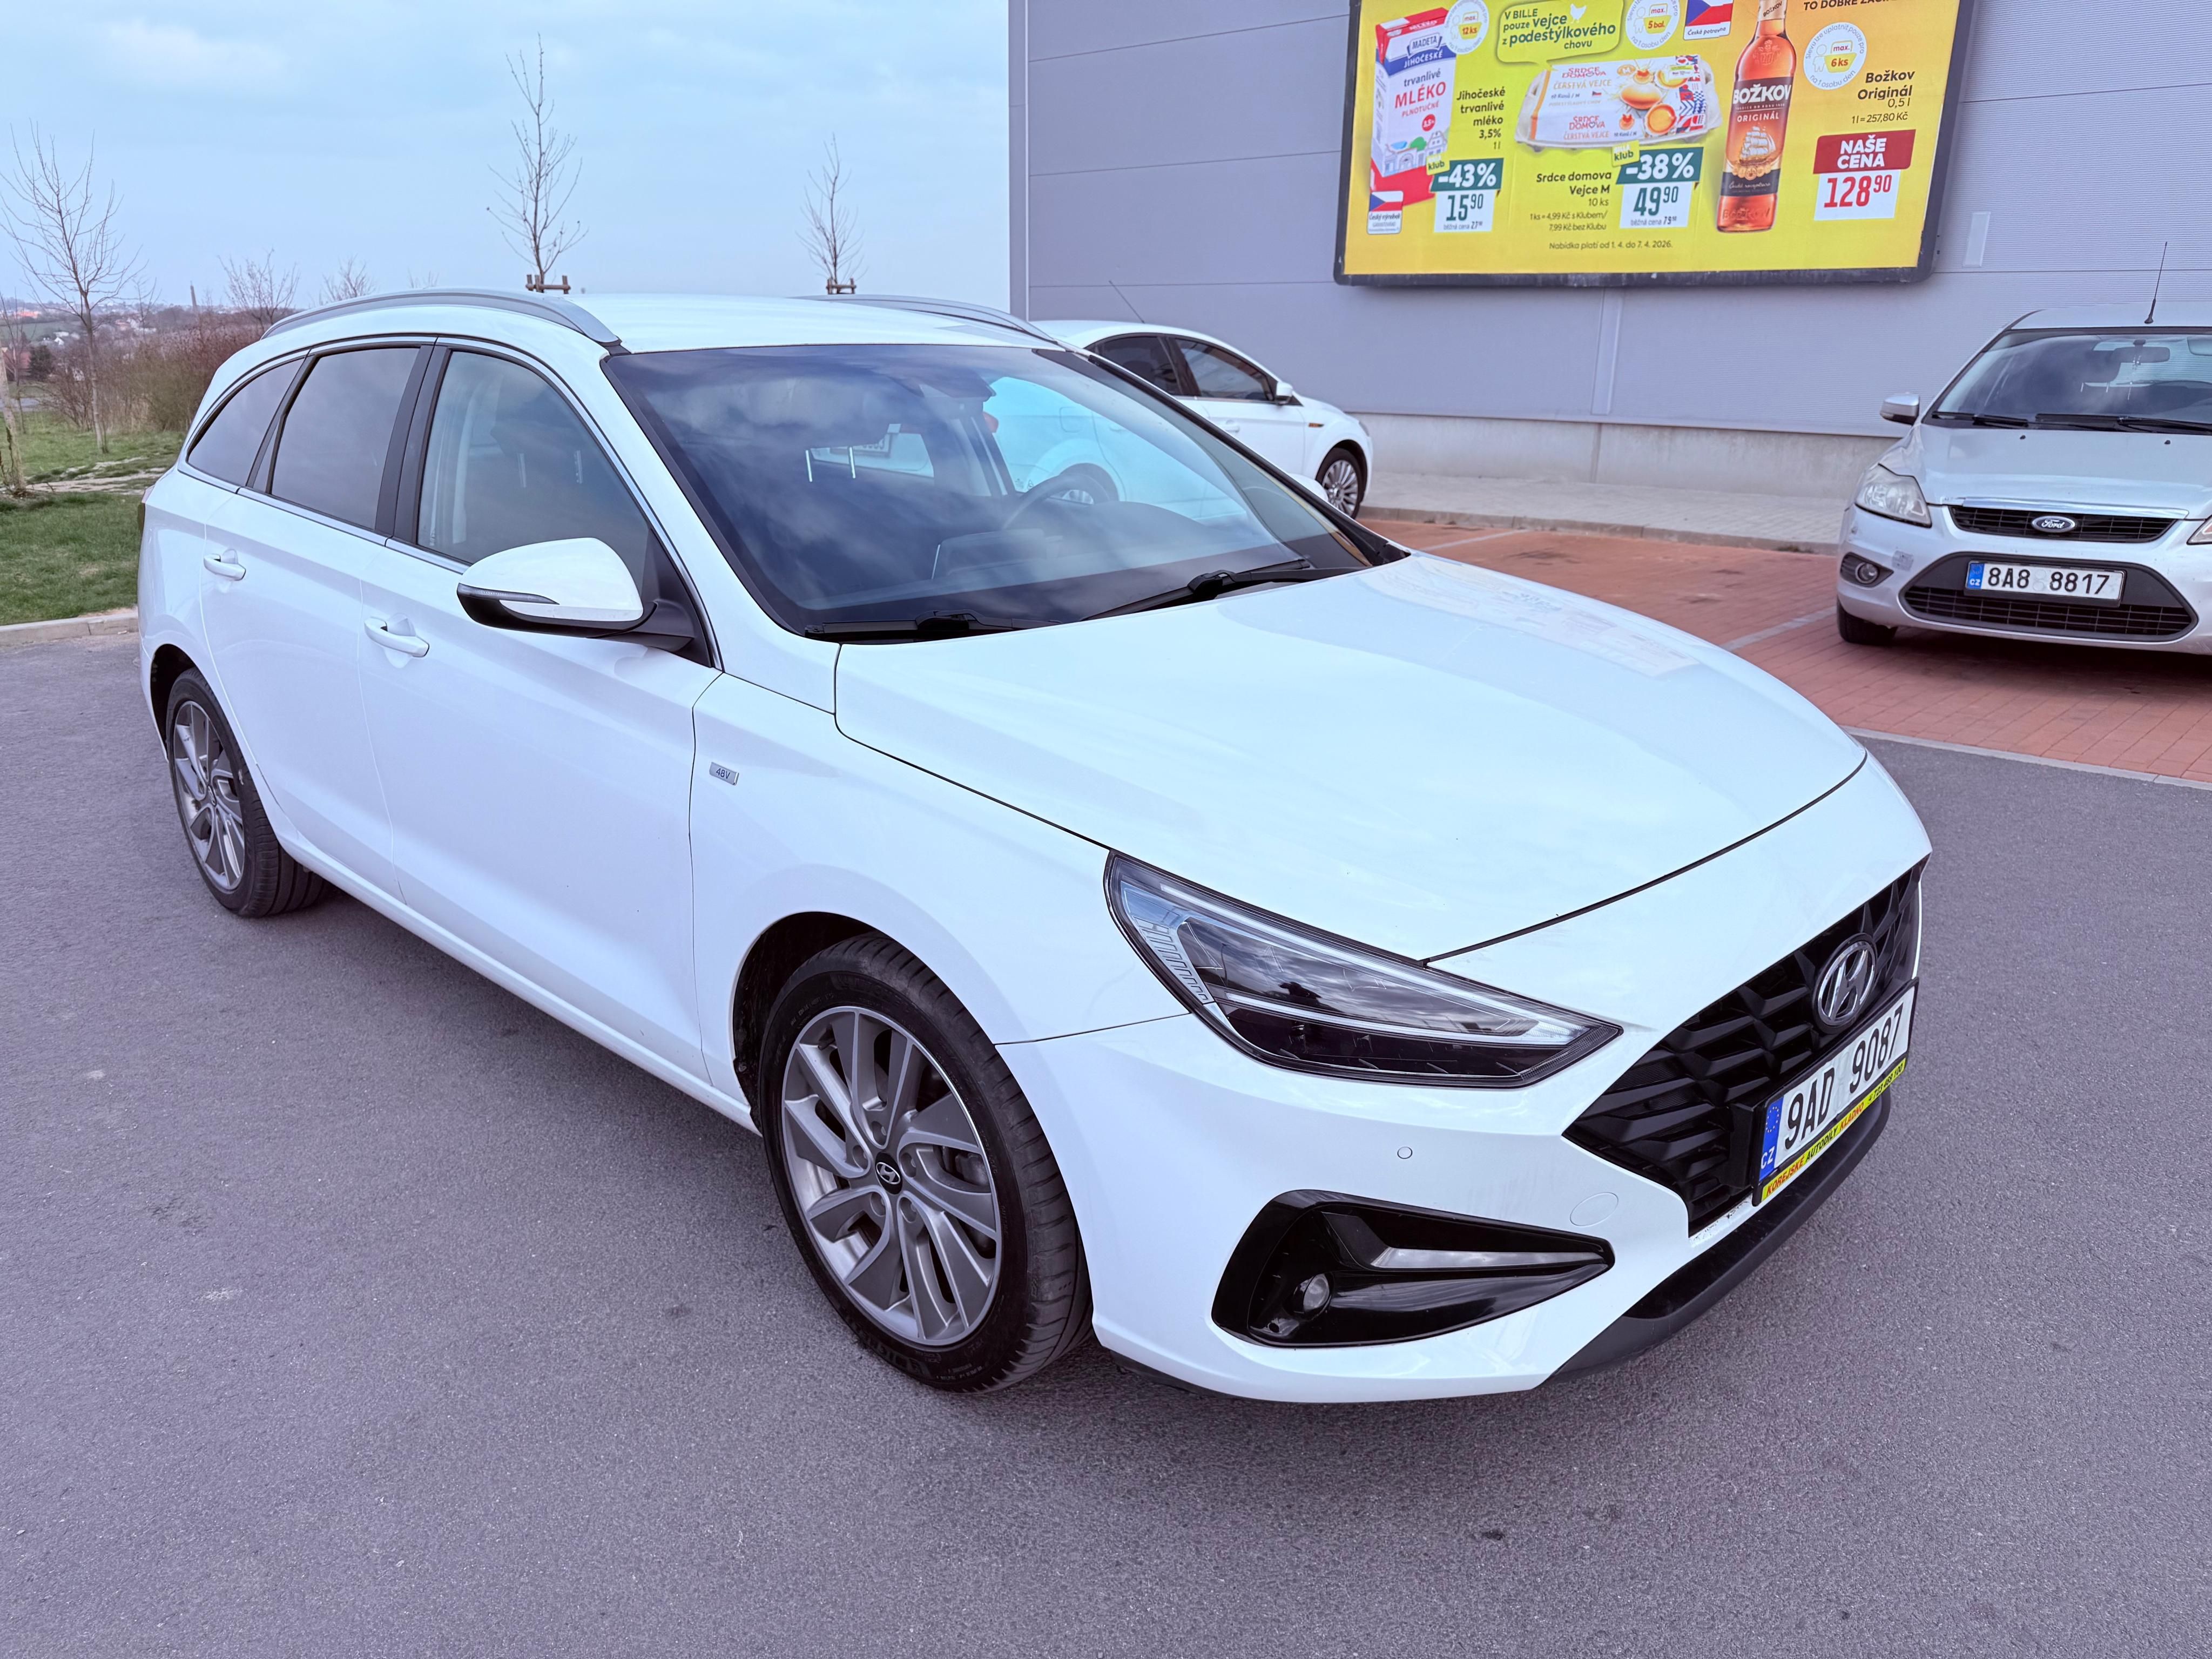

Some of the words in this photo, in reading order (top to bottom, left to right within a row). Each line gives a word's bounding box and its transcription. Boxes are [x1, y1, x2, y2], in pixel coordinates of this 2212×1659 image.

[1804, 2, 1818, 10] TO
[1505, 12, 1510, 20] V
[1513, 9, 1538, 19] BILLE
[1503, 22, 1530, 32] pouze
[1533, 14, 1567, 29] vejce
[1648, 21, 1653, 29] 5
[1509, 23, 1616, 47] podestýlkového
[1824, 24, 1849, 34] uplatnit
[1849, 26, 1863, 42] pouze
[1412, 36, 1437, 50] MADETA
[1564, 41, 1592, 49] chovu
[1404, 49, 1443, 68] JIHOČESKÉ
[1831, 58, 1837, 67] 6
[1838, 58, 1849, 66] ks
[1404, 69, 1441, 86] trvanlivé
[1589, 79, 1612, 87] VEJCE
[1822, 79, 1842, 88] osobu
[1843, 70, 1856, 82] den
[1865, 70, 1915, 83] Božkov
[1394, 82, 1446, 109] MLÉKO
[1456, 86, 1506, 100] Jihočeské
[1732, 83, 1791, 105] BOŽKOV
[1858, 85, 1912, 100] Originál
[1460, 100, 1504, 114] trvanlivé
[1888, 98, 1905, 108] 0,5
[1473, 116, 1503, 126] mléko
[1737, 111, 1779, 123] ORIGINÁL
[1866, 112, 1895, 123] 257,80
[1896, 111, 1908, 120] Kč
[1479, 128, 1502, 140] 3,5%
[1840, 134, 1887, 154] NAŠE
[1614, 150, 1634, 161] klub
[1837, 153, 1885, 169] CENA
[1428, 160, 1445, 170] klub
[1626, 152, 1694, 180] -38%
[1438, 163, 1496, 187] -43%
[1536, 173, 1566, 183] Srdce
[1568, 171, 1611, 181] domova
[1569, 185, 1599, 197] Vejce
[1601, 184, 1610, 194] M
[1588, 198, 1598, 206] 10
[1600, 197, 1609, 206] ks
[1549, 241, 1580, 249] Nabídka
[1581, 241, 1599, 251] platí
[1652, 240, 1673, 248] 2026.
[2041, 518, 2065, 529] Ford
[1988, 567, 2031, 589] 8A8
[2049, 571, 2110, 595] 8817
[716, 768, 731, 779] 48V
[1761, 1145, 1775, 1169] CZ
[1785, 1067, 1835, 1150] 9AD
[1850, 1002, 1904, 1094] 9087
[1766, 1156, 1805, 1197] KOREJSKÉ
[1806, 1128, 1838, 1162] AUTODÍLY
[1839, 1102, 1865, 1131] KLADNO
